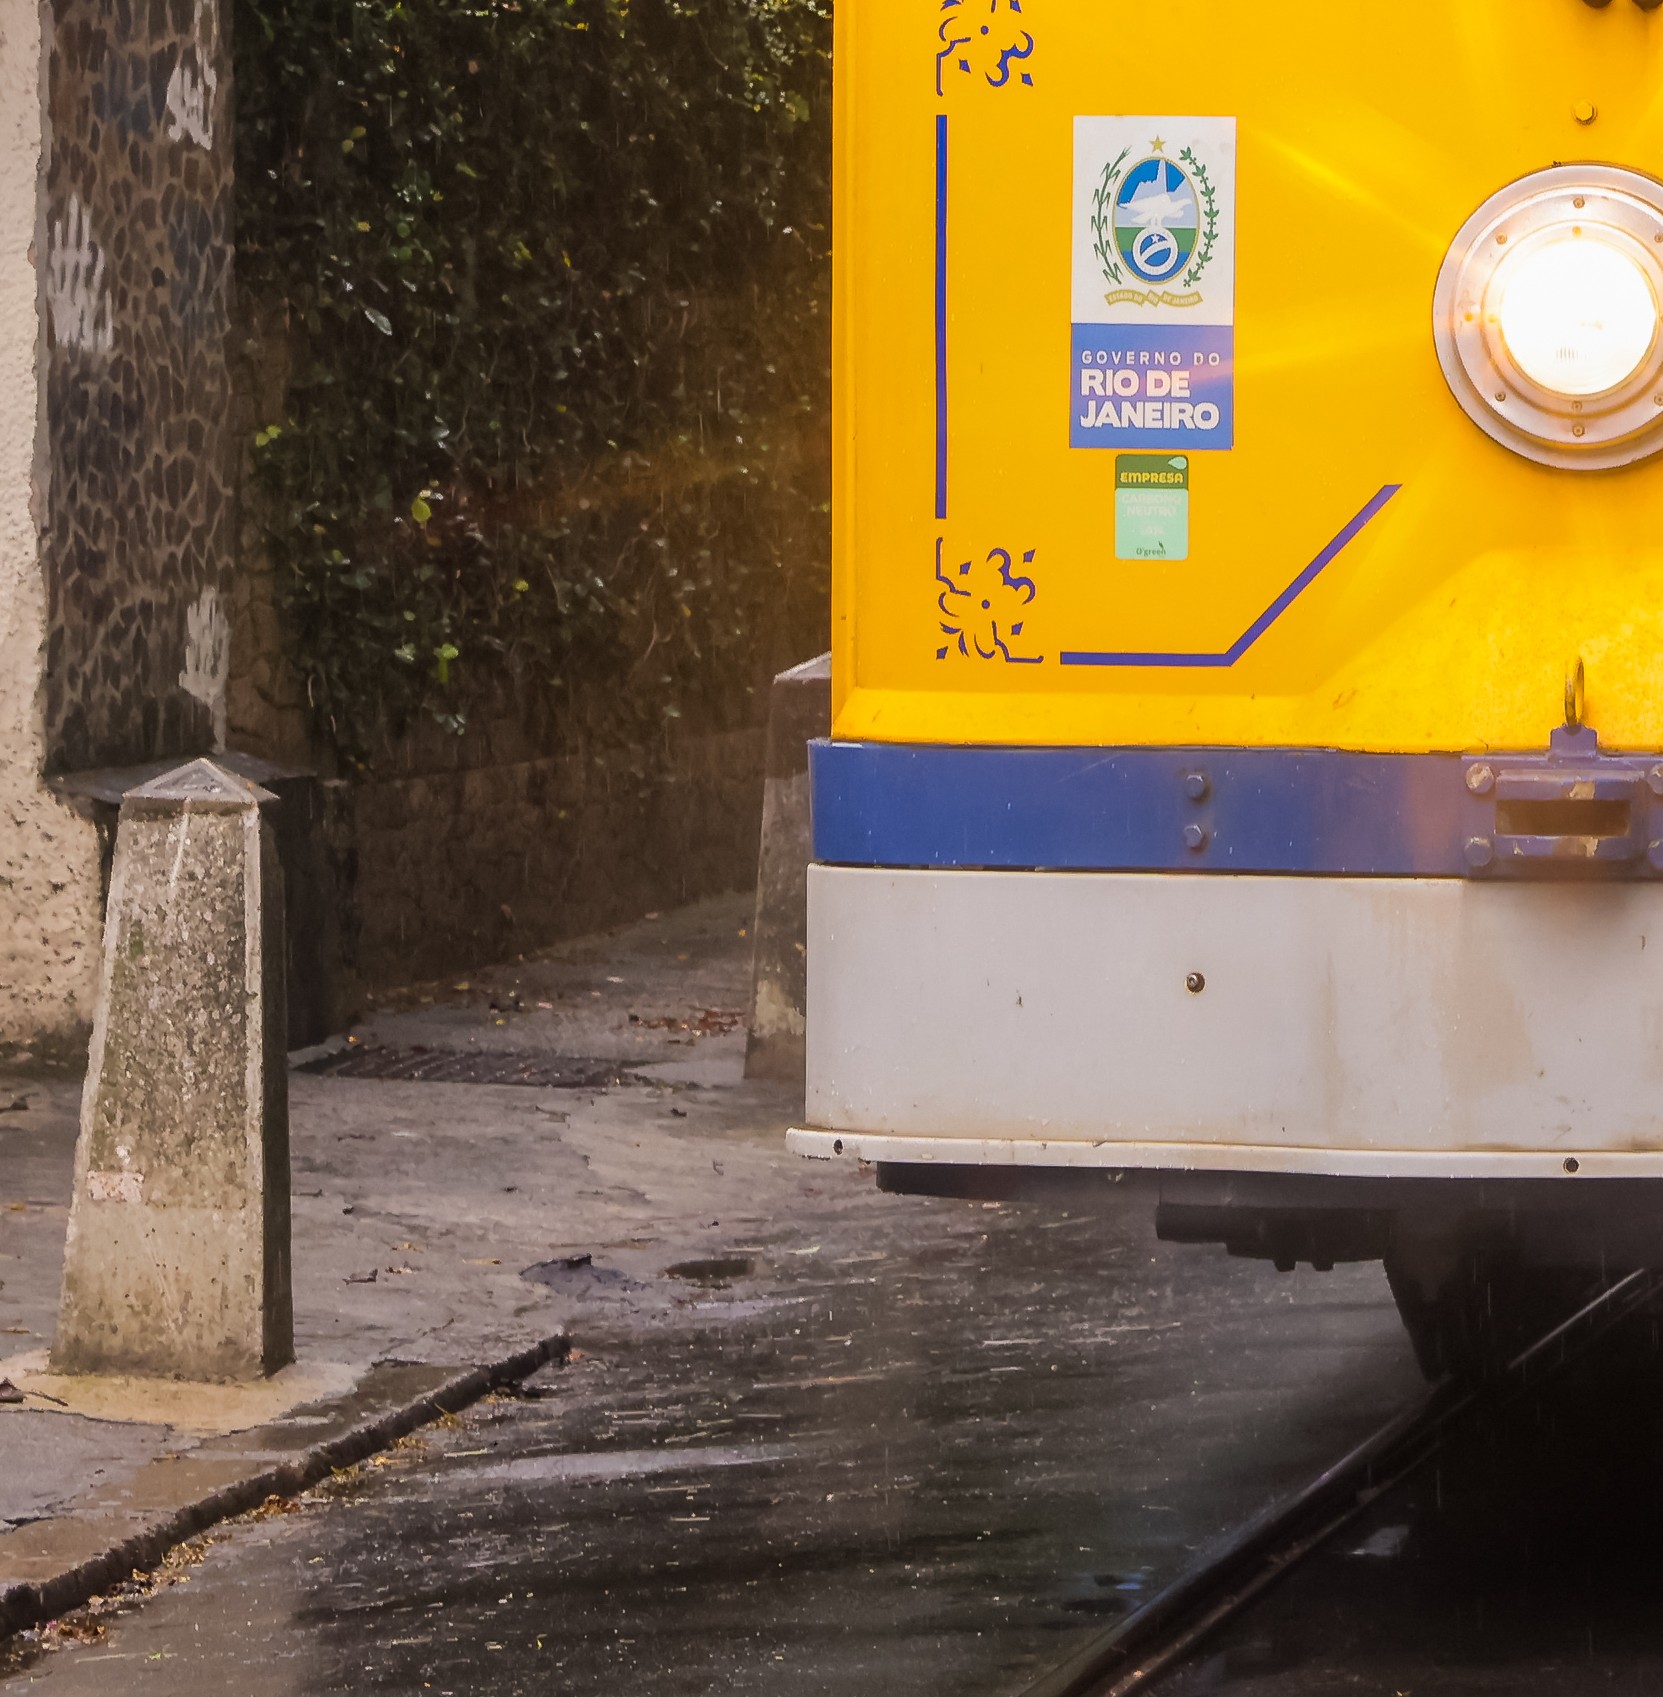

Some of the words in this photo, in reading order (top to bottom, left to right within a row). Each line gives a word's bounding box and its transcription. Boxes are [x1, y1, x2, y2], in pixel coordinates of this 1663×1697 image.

[1082, 350, 1181, 366] GOVERNO
[1193, 352, 1220, 366] DO
[1081, 368, 1139, 397] RIO
[1146, 369, 1191, 398] DE
[1080, 400, 1220, 430] JANEIRO
[1120, 472, 1184, 484] EMPRESA
